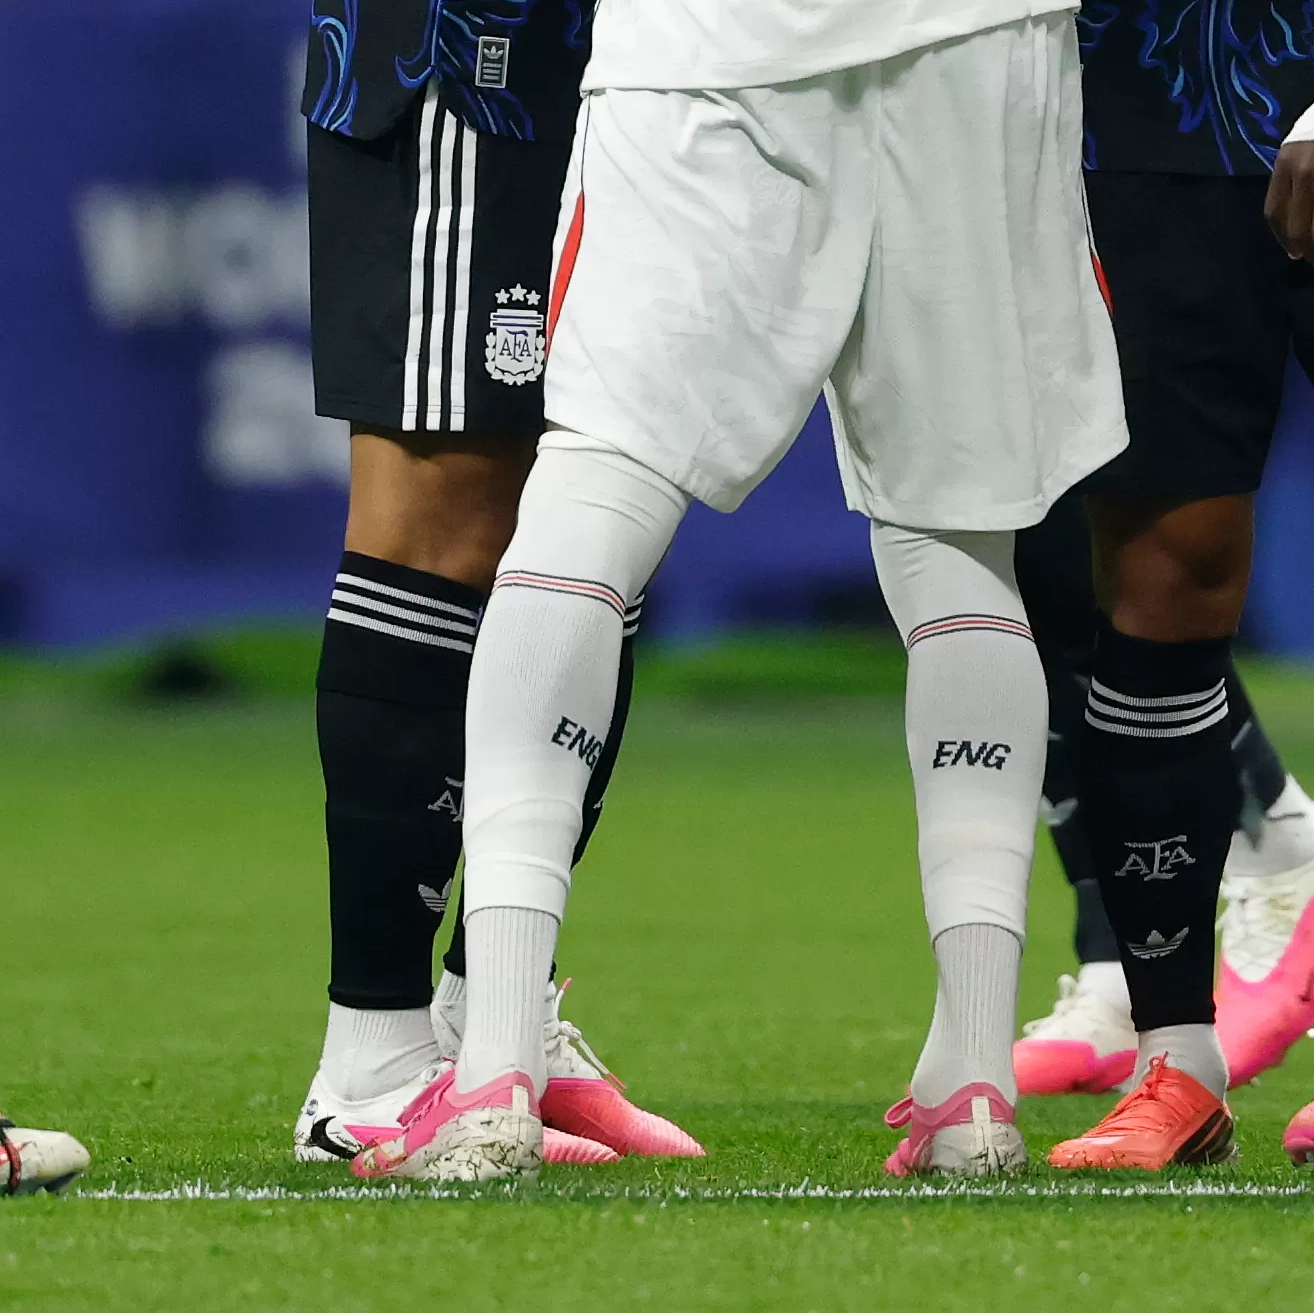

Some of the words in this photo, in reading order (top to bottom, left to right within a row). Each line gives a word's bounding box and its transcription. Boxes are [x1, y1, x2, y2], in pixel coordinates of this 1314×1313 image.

[499, 328, 532, 363] AFA
[550, 715, 604, 772] ENG
[932, 739, 1012, 771] ENG
